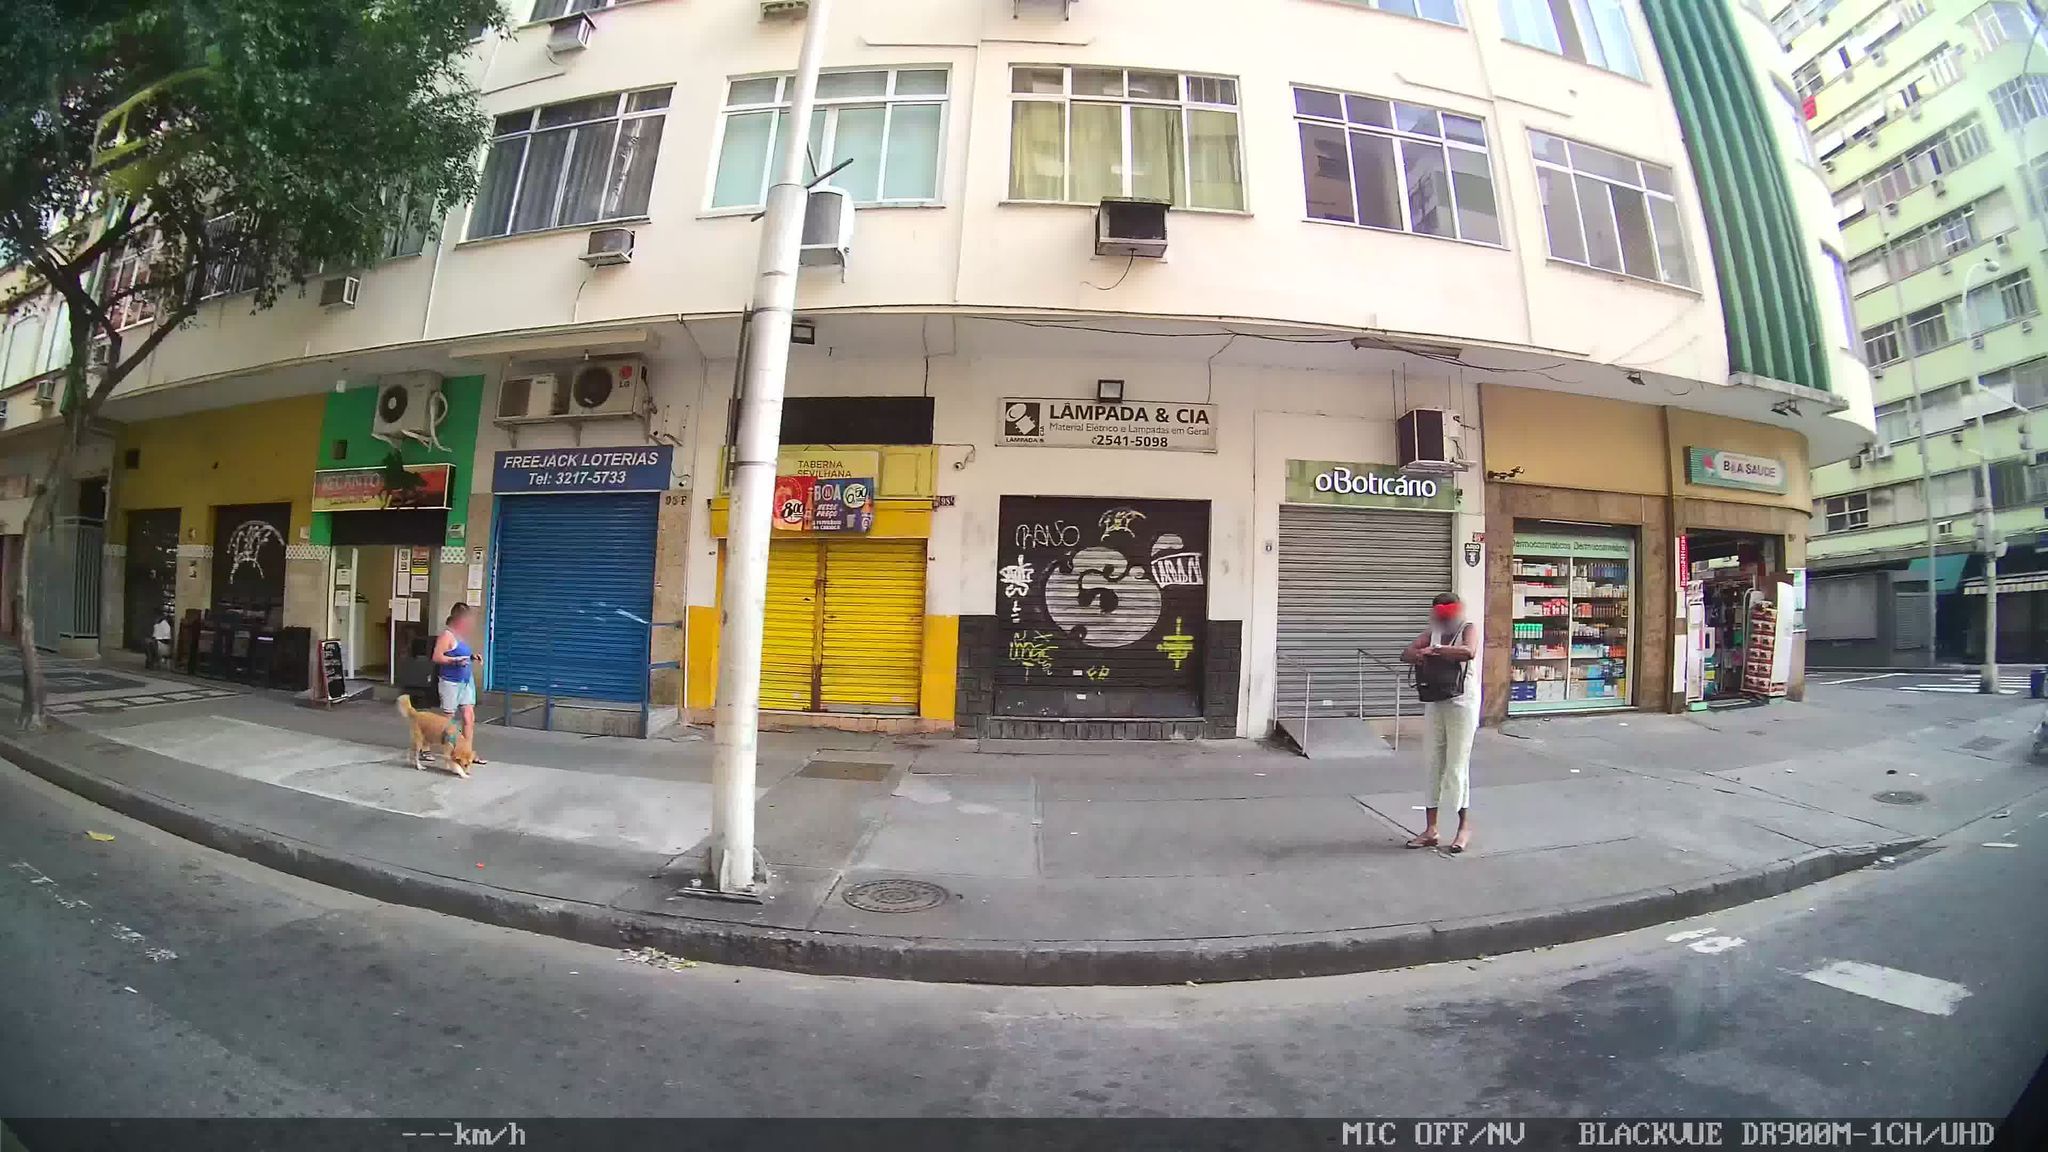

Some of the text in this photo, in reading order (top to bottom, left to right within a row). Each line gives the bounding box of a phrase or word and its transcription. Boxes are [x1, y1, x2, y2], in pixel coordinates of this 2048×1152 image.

[619, 380, 630, 388] LG
[1050, 403, 1210, 424] LÂMPADA & CIA
[1049, 422, 1084, 432] Material
[1171, 427, 1184, 435] em
[1187, 427, 1210, 436] Geral
[1096, 435, 1168, 448] 2541-5098
[503, 452, 658, 469] FREEJACK LOTERIAS
[797, 460, 843, 468] TABERNA
[529, 471, 626, 485] Tel: 3217-5733
[797, 469, 851, 477] SEVILHANA
[814, 484, 841, 501] BOA
